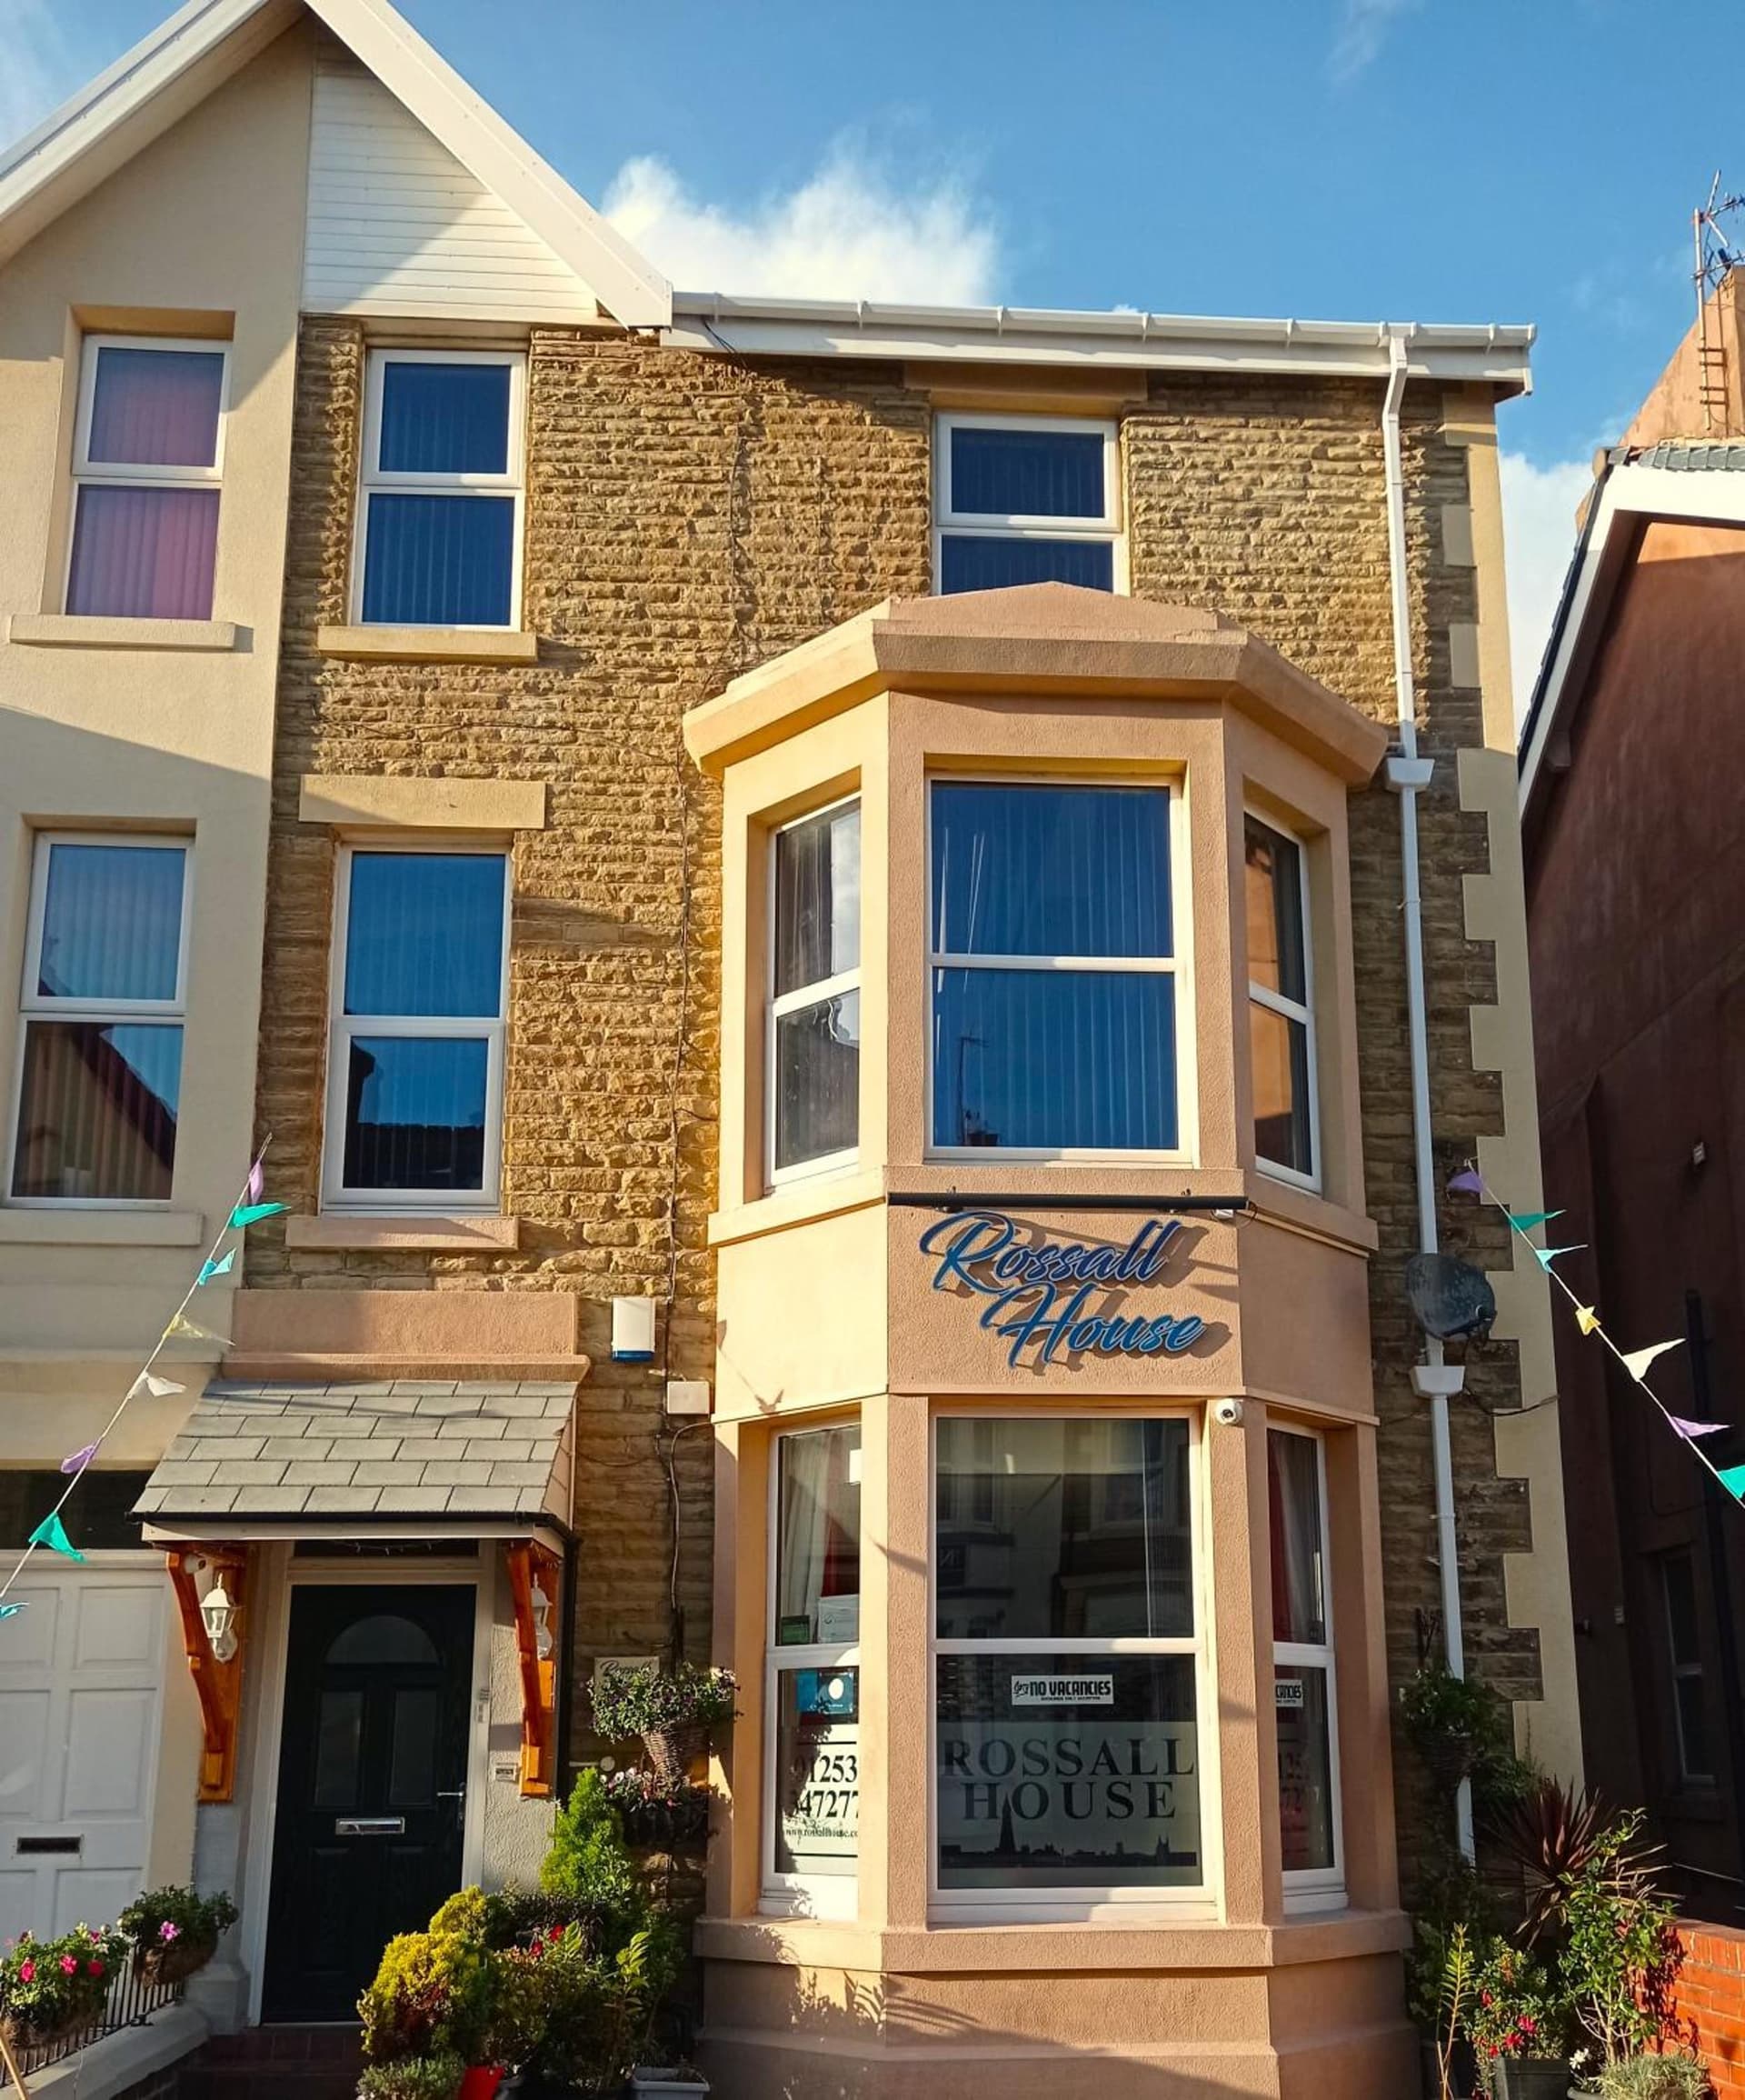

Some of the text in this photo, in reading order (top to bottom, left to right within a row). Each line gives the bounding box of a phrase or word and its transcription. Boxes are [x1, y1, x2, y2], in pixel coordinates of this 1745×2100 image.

[919, 1210, 1182, 1295] Rossall
[980, 1282, 1206, 1369] House
[1030, 1681, 1046, 1696] NO
[1049, 1680, 1111, 1696] VACANCIES
[942, 1737, 1194, 1776] ROSSALL
[960, 1782, 1176, 1820] HOUSE
